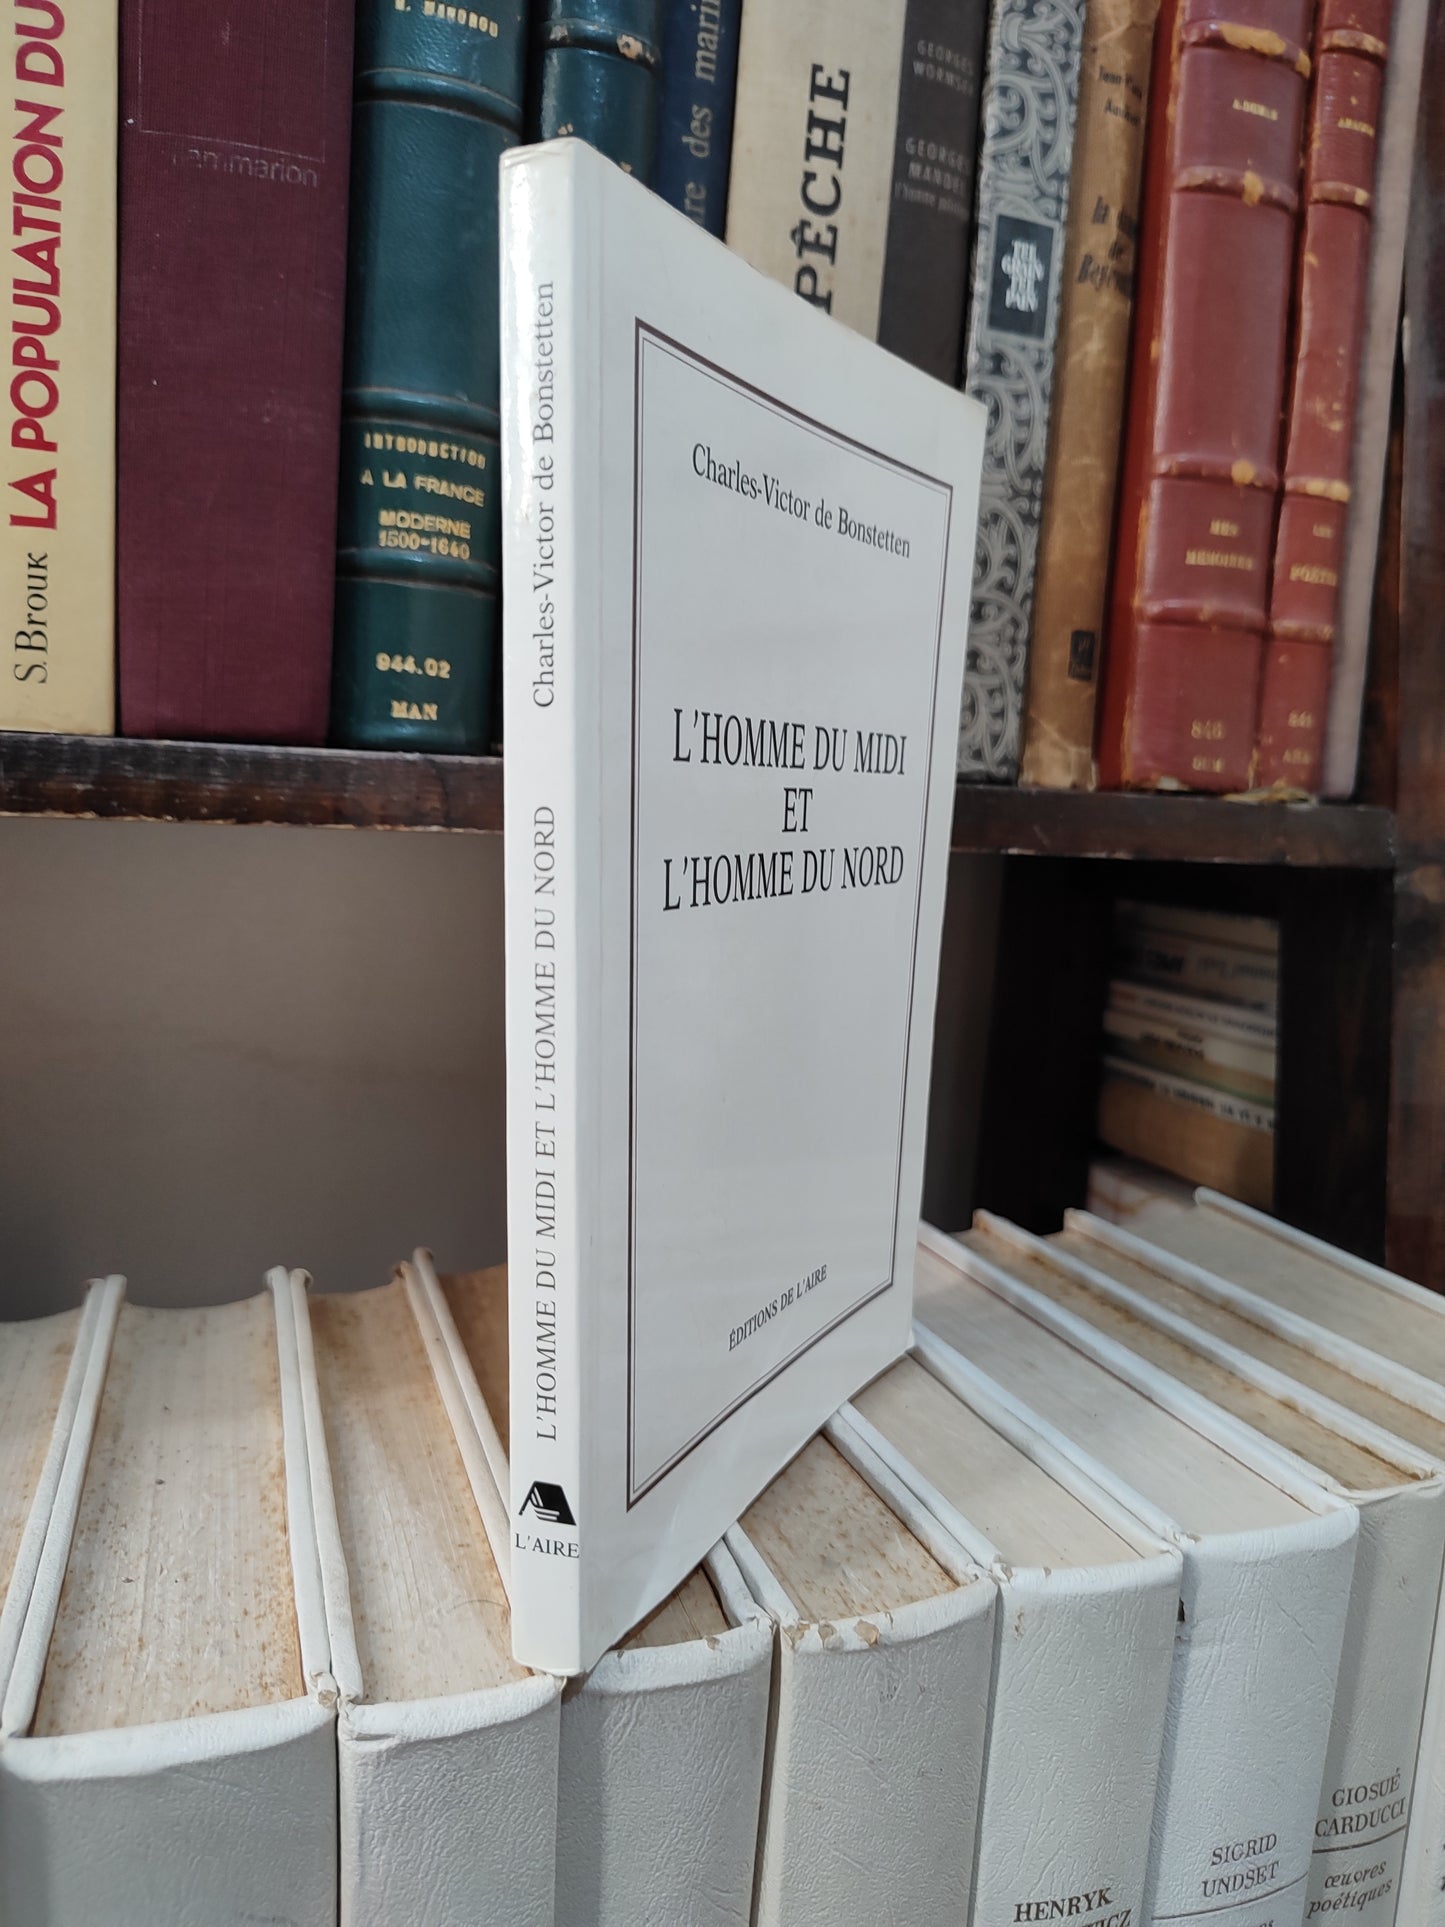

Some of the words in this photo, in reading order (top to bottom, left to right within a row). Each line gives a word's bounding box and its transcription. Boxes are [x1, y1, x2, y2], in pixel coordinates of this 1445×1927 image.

[14, 0, 66, 88] DU
[690, 0, 722, 82] mari
[681, 104, 714, 158] des
[10, 99, 65, 452] POPULATION
[532, 280, 554, 444] Bonstetten
[364, 431, 486, 470] INTRODUCTION
[532, 455, 554, 491] de
[9, 467, 58, 530] LA
[360, 468, 374, 486] A
[382, 470, 407, 489] LA
[414, 474, 485, 507] FRANCE
[692, 442, 811, 522] Charles-Victor
[814, 497, 833, 530] de
[837, 506, 911, 559] Bonstetten
[378, 510, 471, 539] MODERNE
[532, 501, 555, 709] Charles-Victor
[391, 700, 438, 721] MAN
[672, 707, 806, 770] L'HOMME
[812, 725, 848, 772] DU
[853, 730, 908, 775] MIDI
[781, 787, 814, 833] ET
[533, 805, 556, 897] NORD
[662, 850, 794, 912] L'HOMME
[801, 848, 836, 893] DU
[840, 845, 905, 889] NORD
[534, 907, 557, 952] DU
[534, 961, 557, 1112] L'HOMME
[534, 1121, 557, 1160] ET
[535, 1168, 557, 1241] MIDI
[535, 1247, 557, 1292] DU
[728, 1298, 778, 1352] ÉDITIONS
[780, 1286, 794, 1312] DE
[796, 1263, 828, 1300] L'AIRE
[534, 1299, 558, 1443] L'HOMME
[515, 1532, 580, 1559] L'AIRE
[1332, 1768, 1401, 1807] GIOSUÉ
[1315, 1797, 1406, 1838] CARDUCCI
[1210, 1833, 1278, 1867] SIGRID
[1201, 1860, 1280, 1898] UNDSET
[1306, 1878, 1393, 1920] poétiques
[1013, 1887, 1113, 1923] HENRYK
